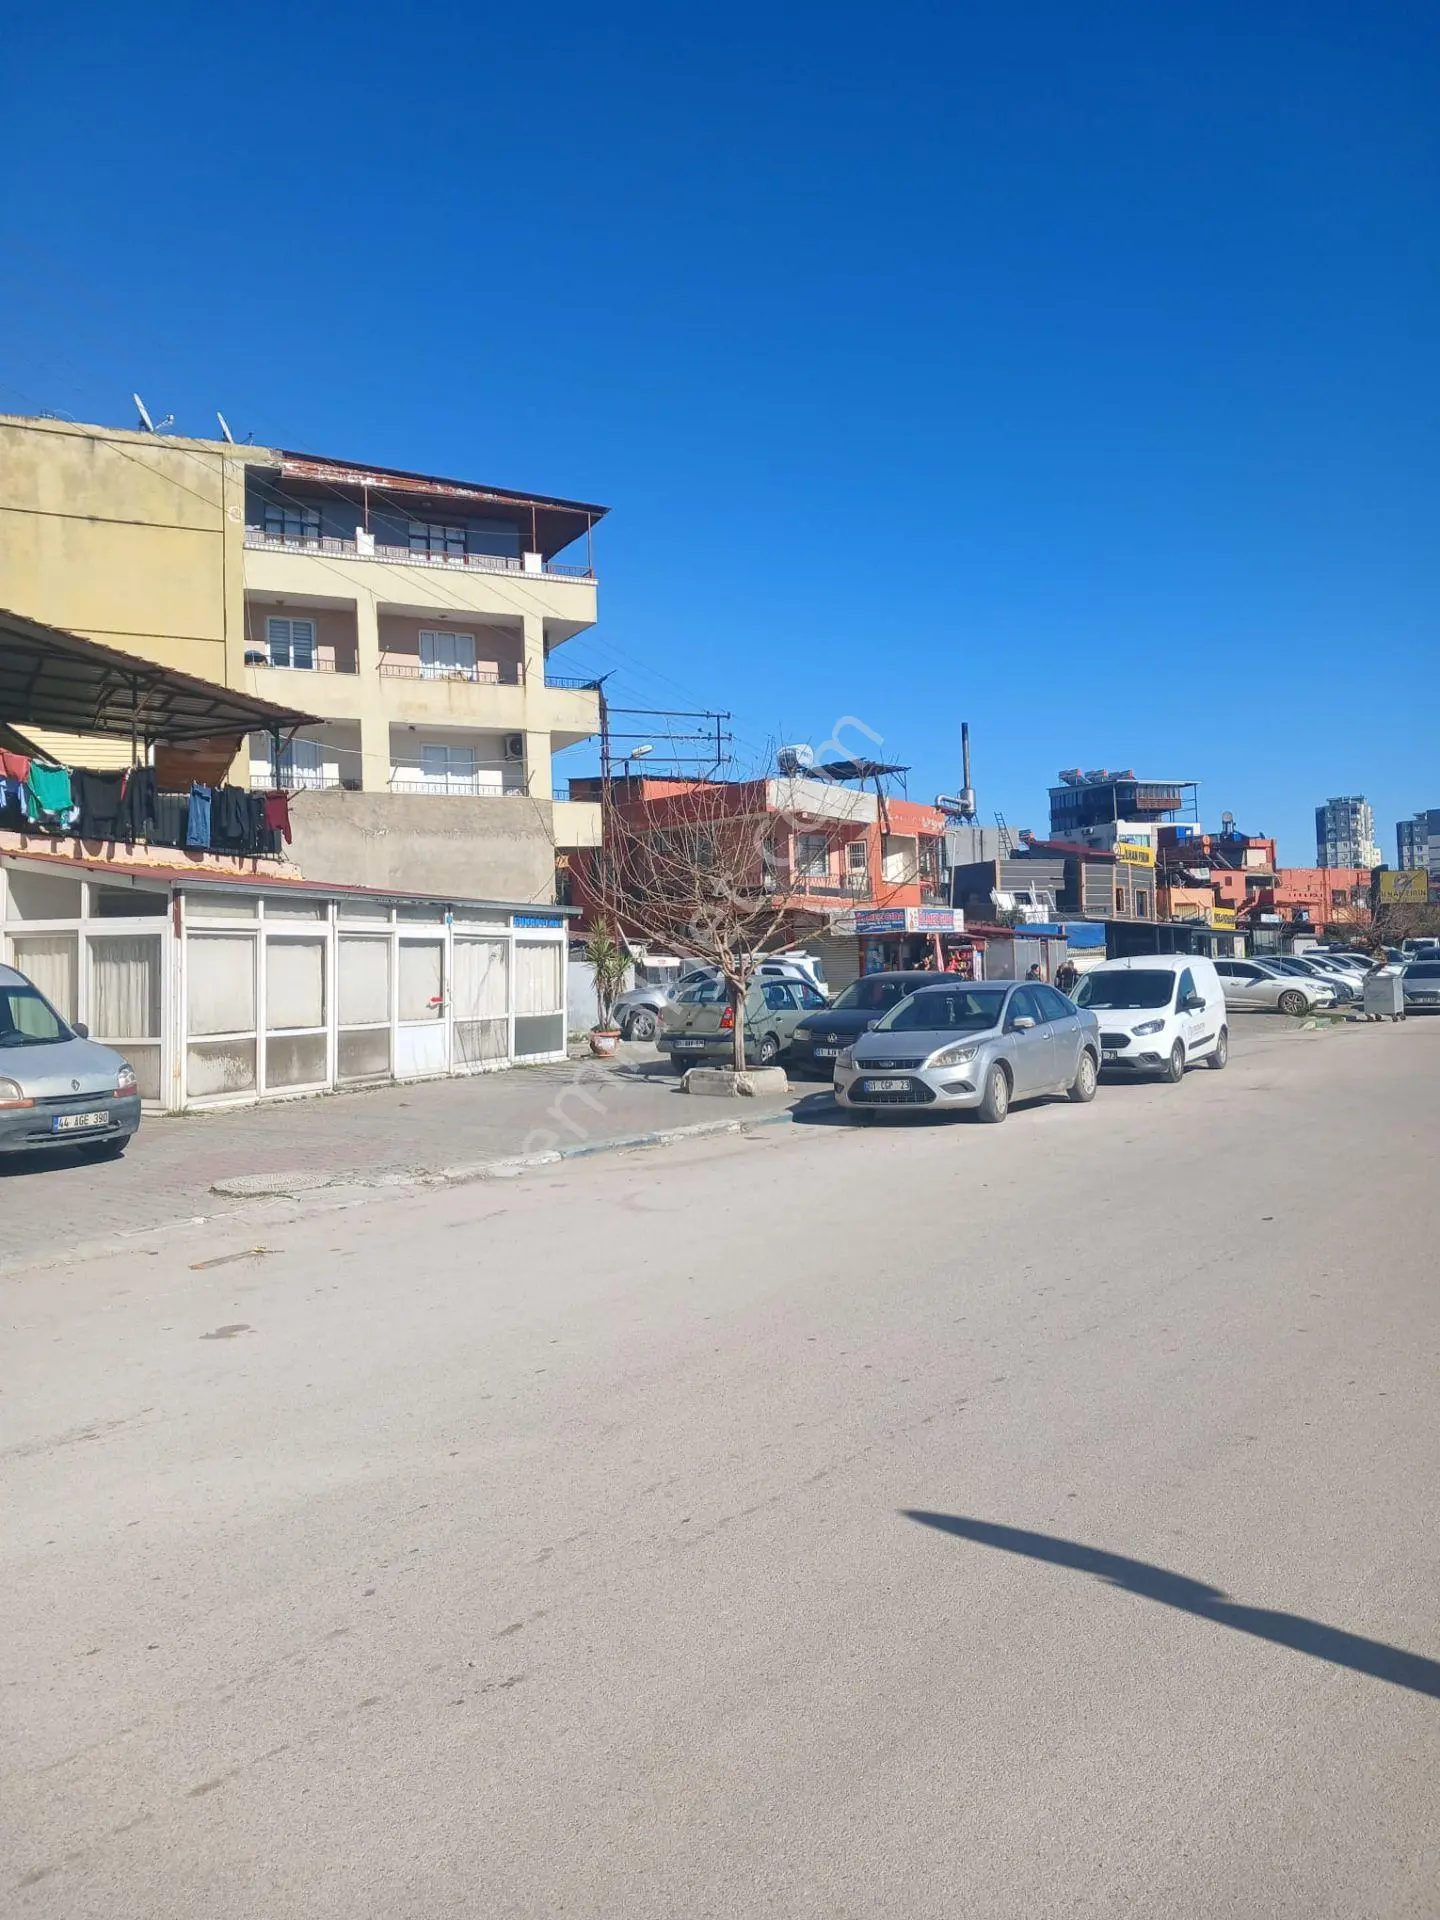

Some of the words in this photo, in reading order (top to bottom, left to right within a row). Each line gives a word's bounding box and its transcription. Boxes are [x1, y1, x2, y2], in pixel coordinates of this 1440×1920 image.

[58, 1116, 69, 1128] 44
[74, 1114, 89, 1126] AGE
[93, 1112, 108, 1124] 390
